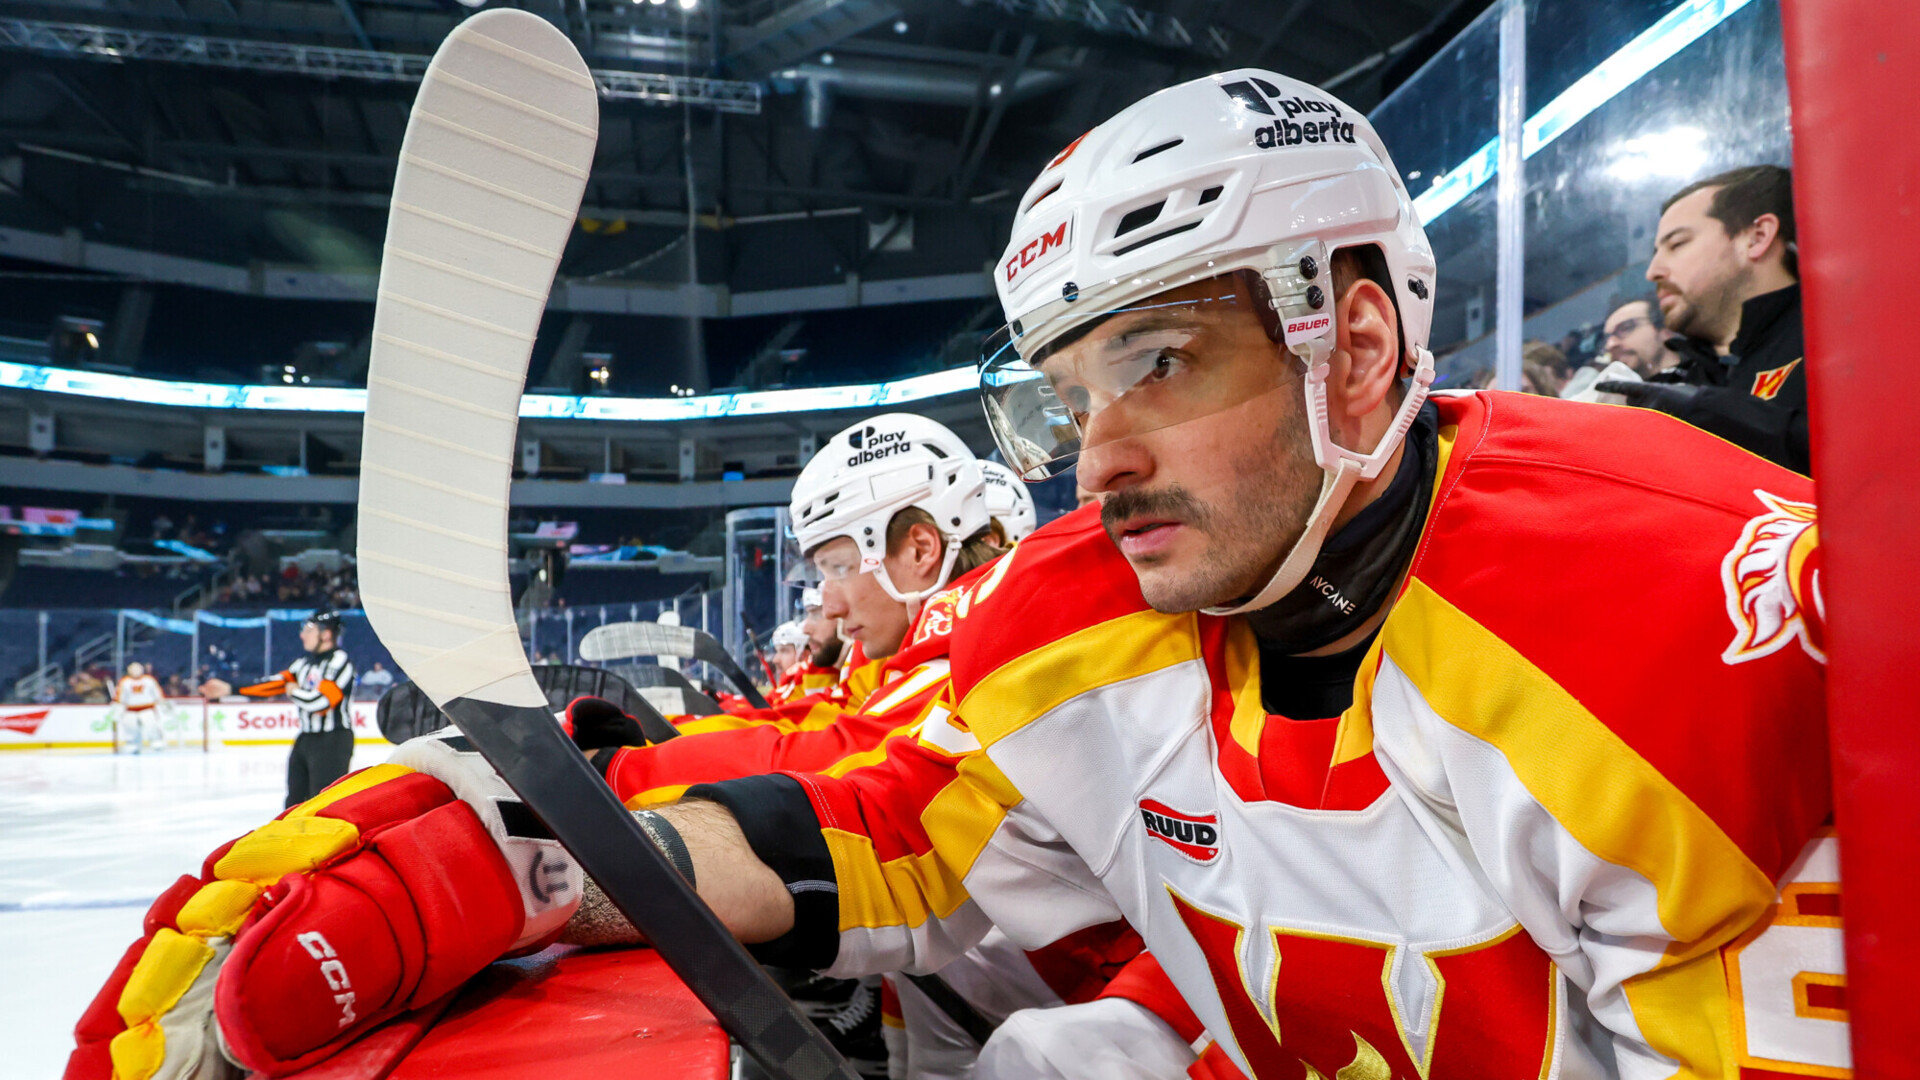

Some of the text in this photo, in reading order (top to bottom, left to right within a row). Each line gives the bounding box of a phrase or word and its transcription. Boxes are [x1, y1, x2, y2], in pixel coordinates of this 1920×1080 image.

[1278, 96, 1341, 118] play
[1255, 116, 1356, 149] alberta
[1006, 221, 1067, 282] CCM
[847, 441, 910, 467] alberta
[868, 430, 905, 449] play
[1309, 575, 1356, 615] AYCANE
[238, 711, 367, 729] Scotiak
[1140, 809, 1217, 846] RUUD
[296, 931, 356, 1028] CCM
